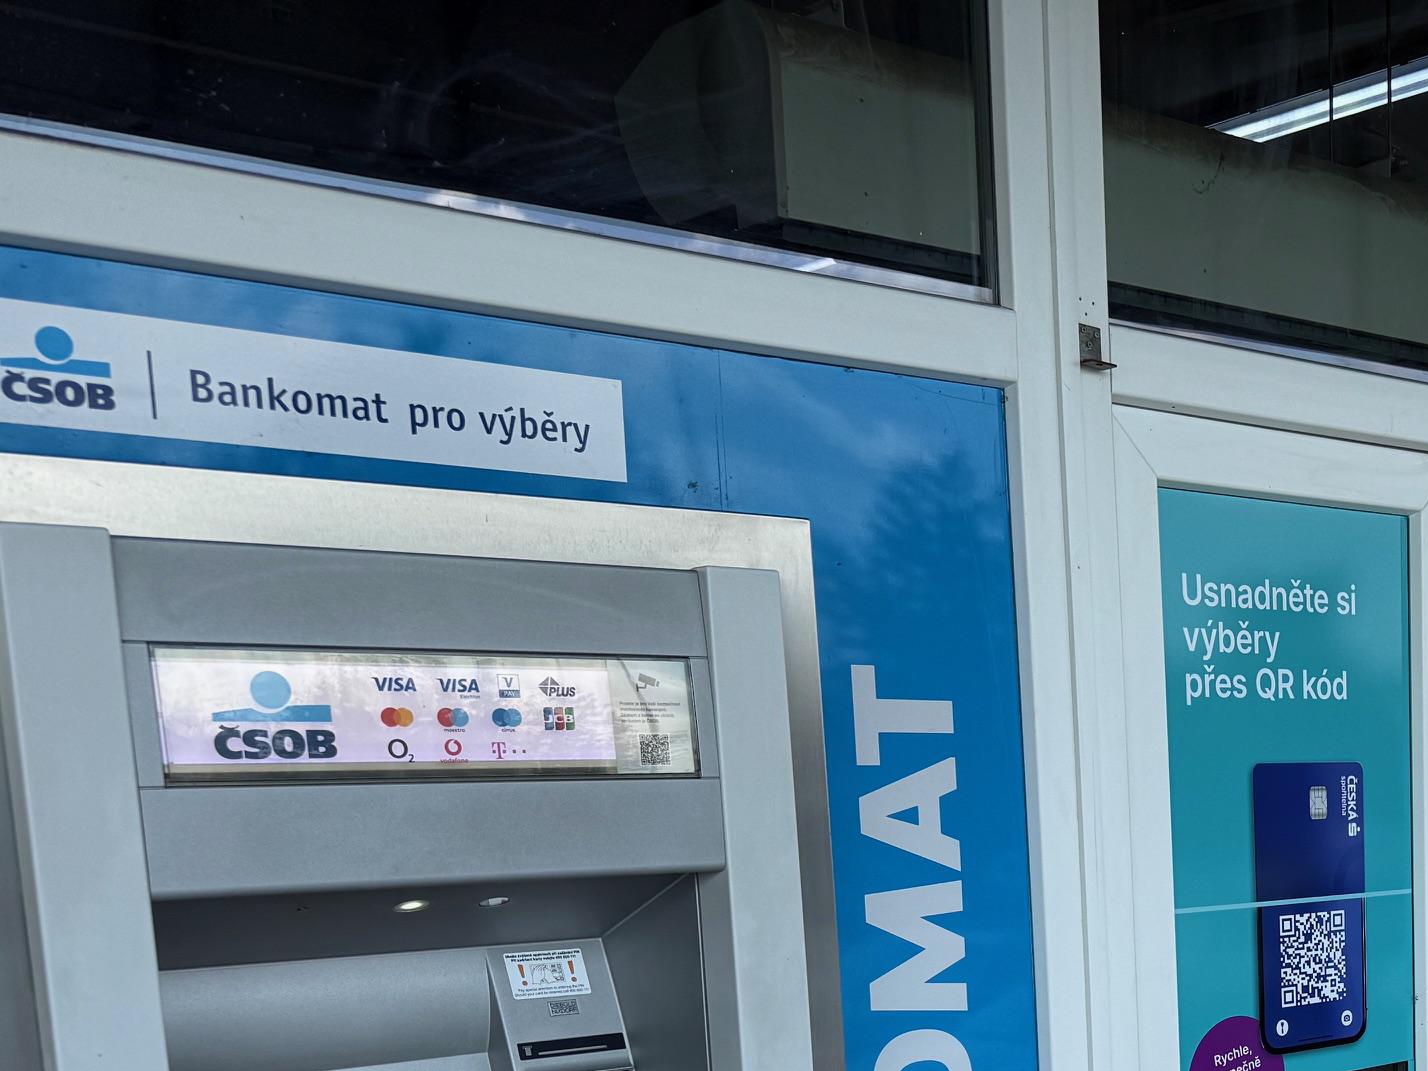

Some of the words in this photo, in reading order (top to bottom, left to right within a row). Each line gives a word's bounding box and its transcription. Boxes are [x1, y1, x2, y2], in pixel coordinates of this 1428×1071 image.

[1, 370, 116, 412] ČSOB
[188, 369, 389, 424] Bankomat
[408, 403, 466, 436] pro
[479, 405, 591, 453] výběry
[1180, 571, 1329, 615] Usnadněte
[1336, 585, 1357, 616] si
[1182, 619, 1281, 663] výběry
[371, 676, 417, 692] VISA
[436, 677, 480, 693] VISA
[549, 686, 576, 697] PLUS
[1184, 666, 1248, 706] přes
[1255, 667, 1295, 703] QR
[1302, 669, 1348, 701] kód
[543, 713, 575, 723] JCB
[214, 723, 338, 760] ČSOB
[1346, 774, 1359, 821] ČESKÁ
[1213, 1044, 1253, 1067] Rychle,
